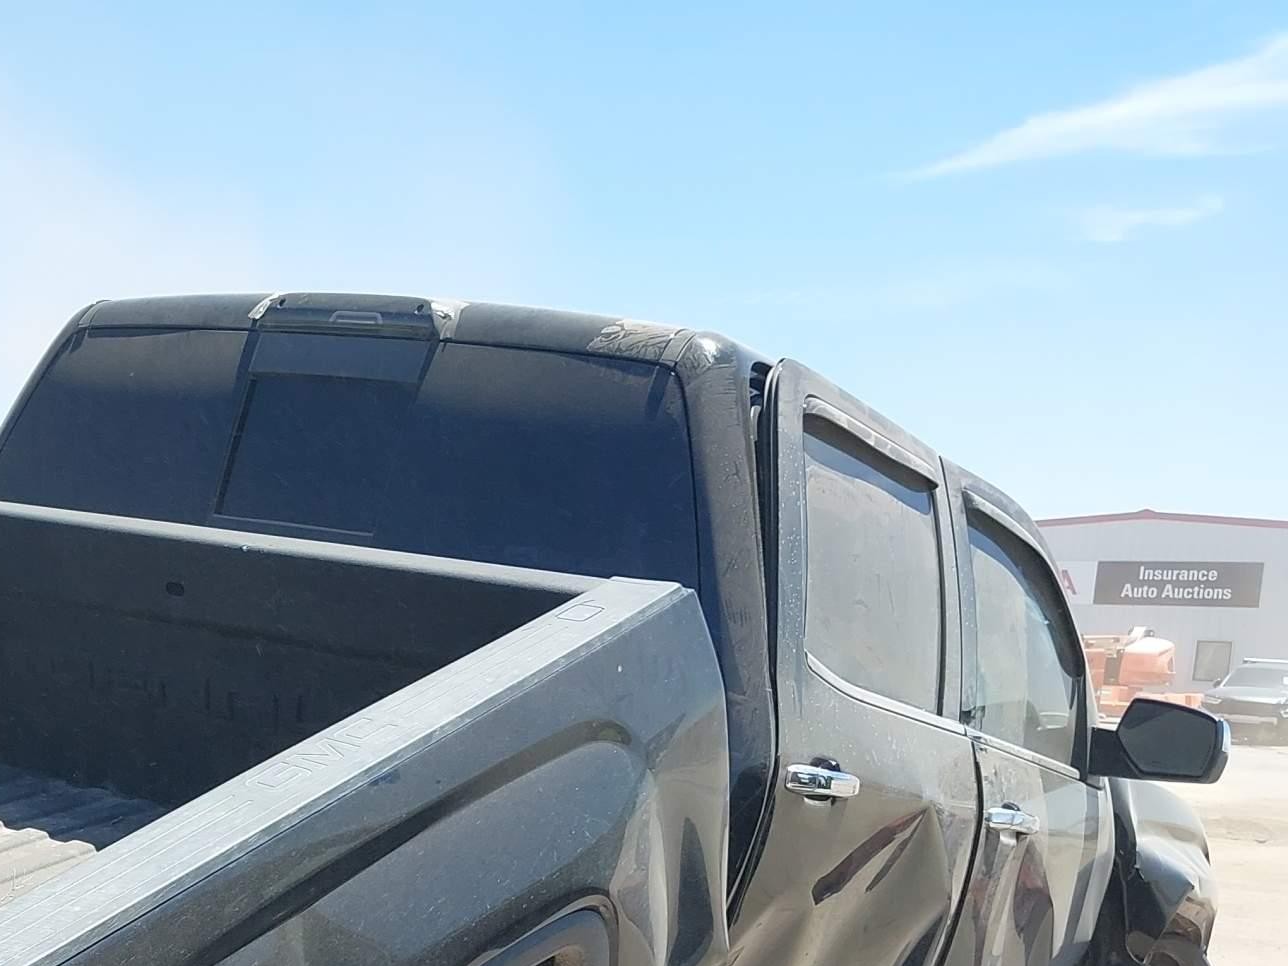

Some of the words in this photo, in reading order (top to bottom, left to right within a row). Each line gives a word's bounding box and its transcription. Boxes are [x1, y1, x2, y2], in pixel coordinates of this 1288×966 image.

[1139, 565, 1218, 581] Insurance
[1120, 583, 1158, 598] Auto
[1162, 583, 1232, 600] Auctions
[245, 716, 399, 791] GMC
